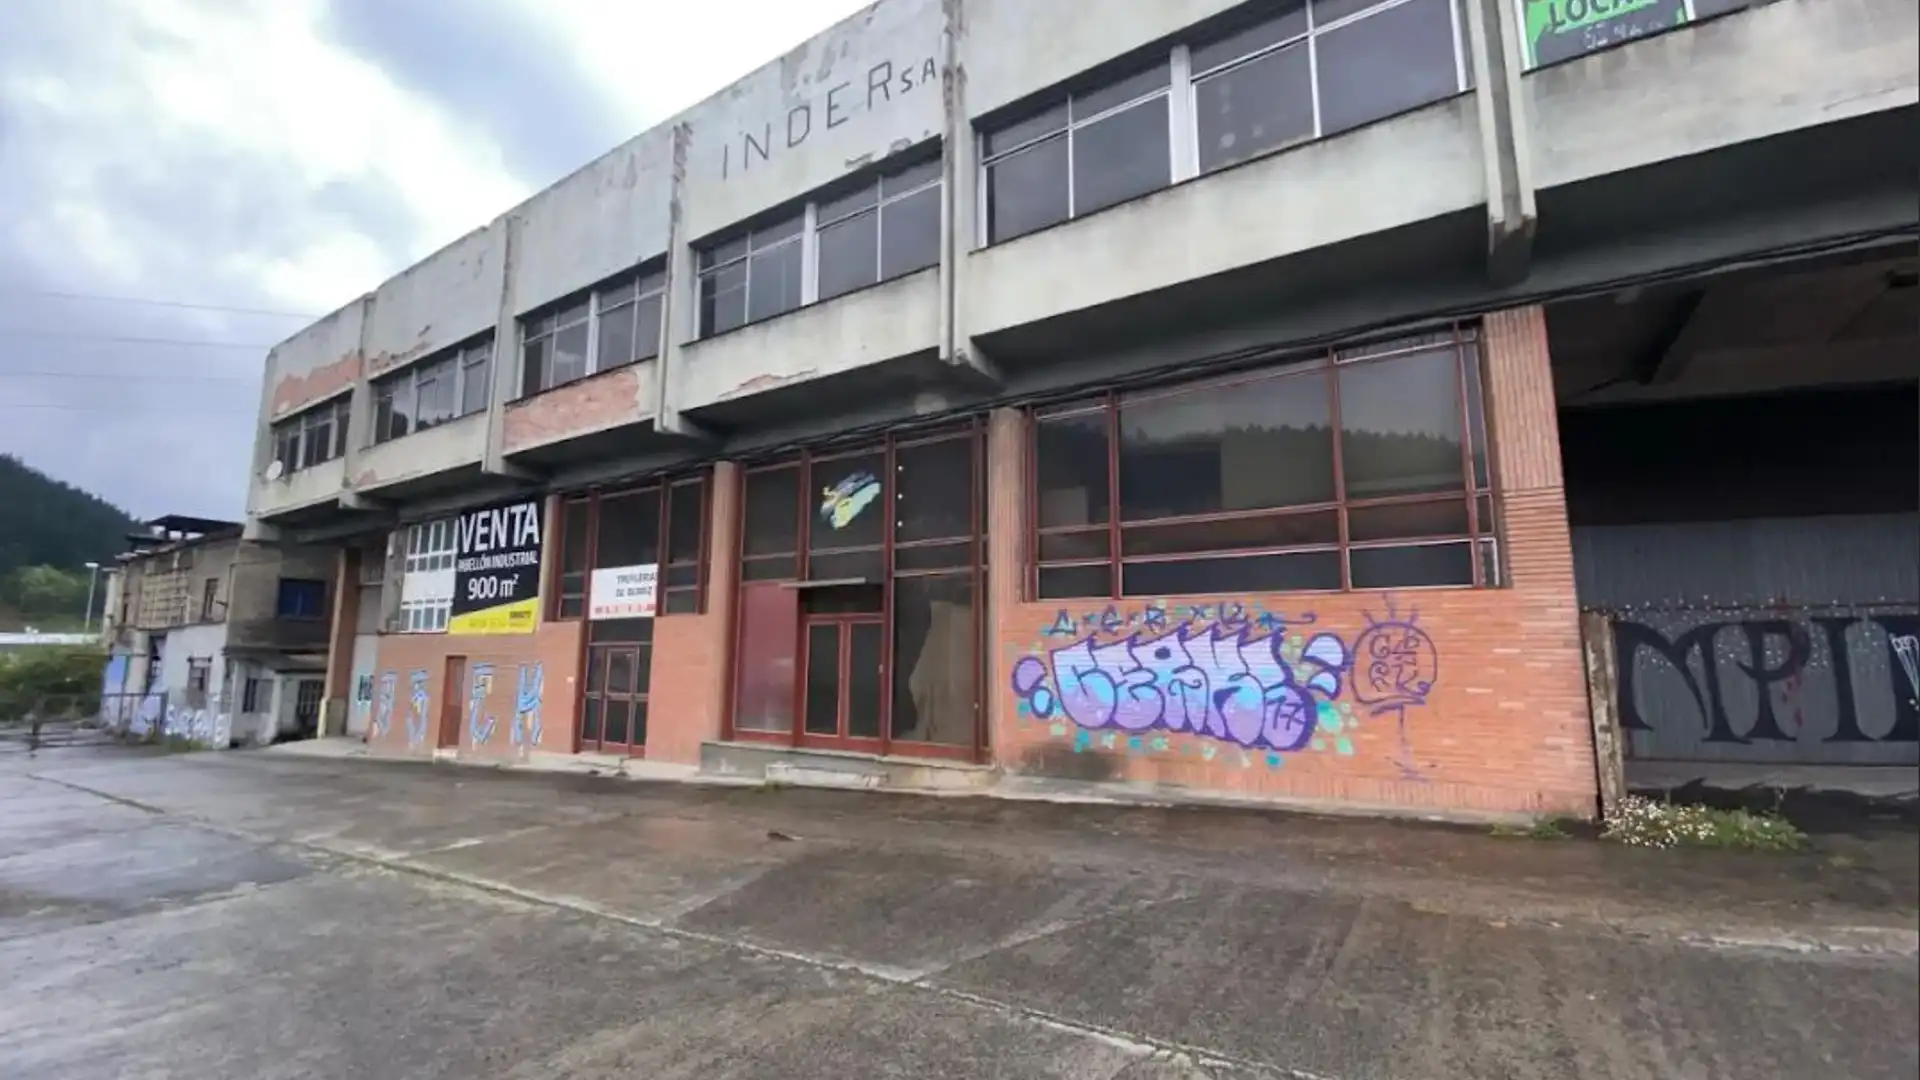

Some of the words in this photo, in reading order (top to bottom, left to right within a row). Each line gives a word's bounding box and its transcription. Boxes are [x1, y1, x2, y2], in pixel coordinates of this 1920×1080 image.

[722, 60, 892, 181] INDER
[460, 501, 540, 554] VENTA
[491, 550, 538, 569] INDUSTRIAL
[467, 576, 498, 600] 900
